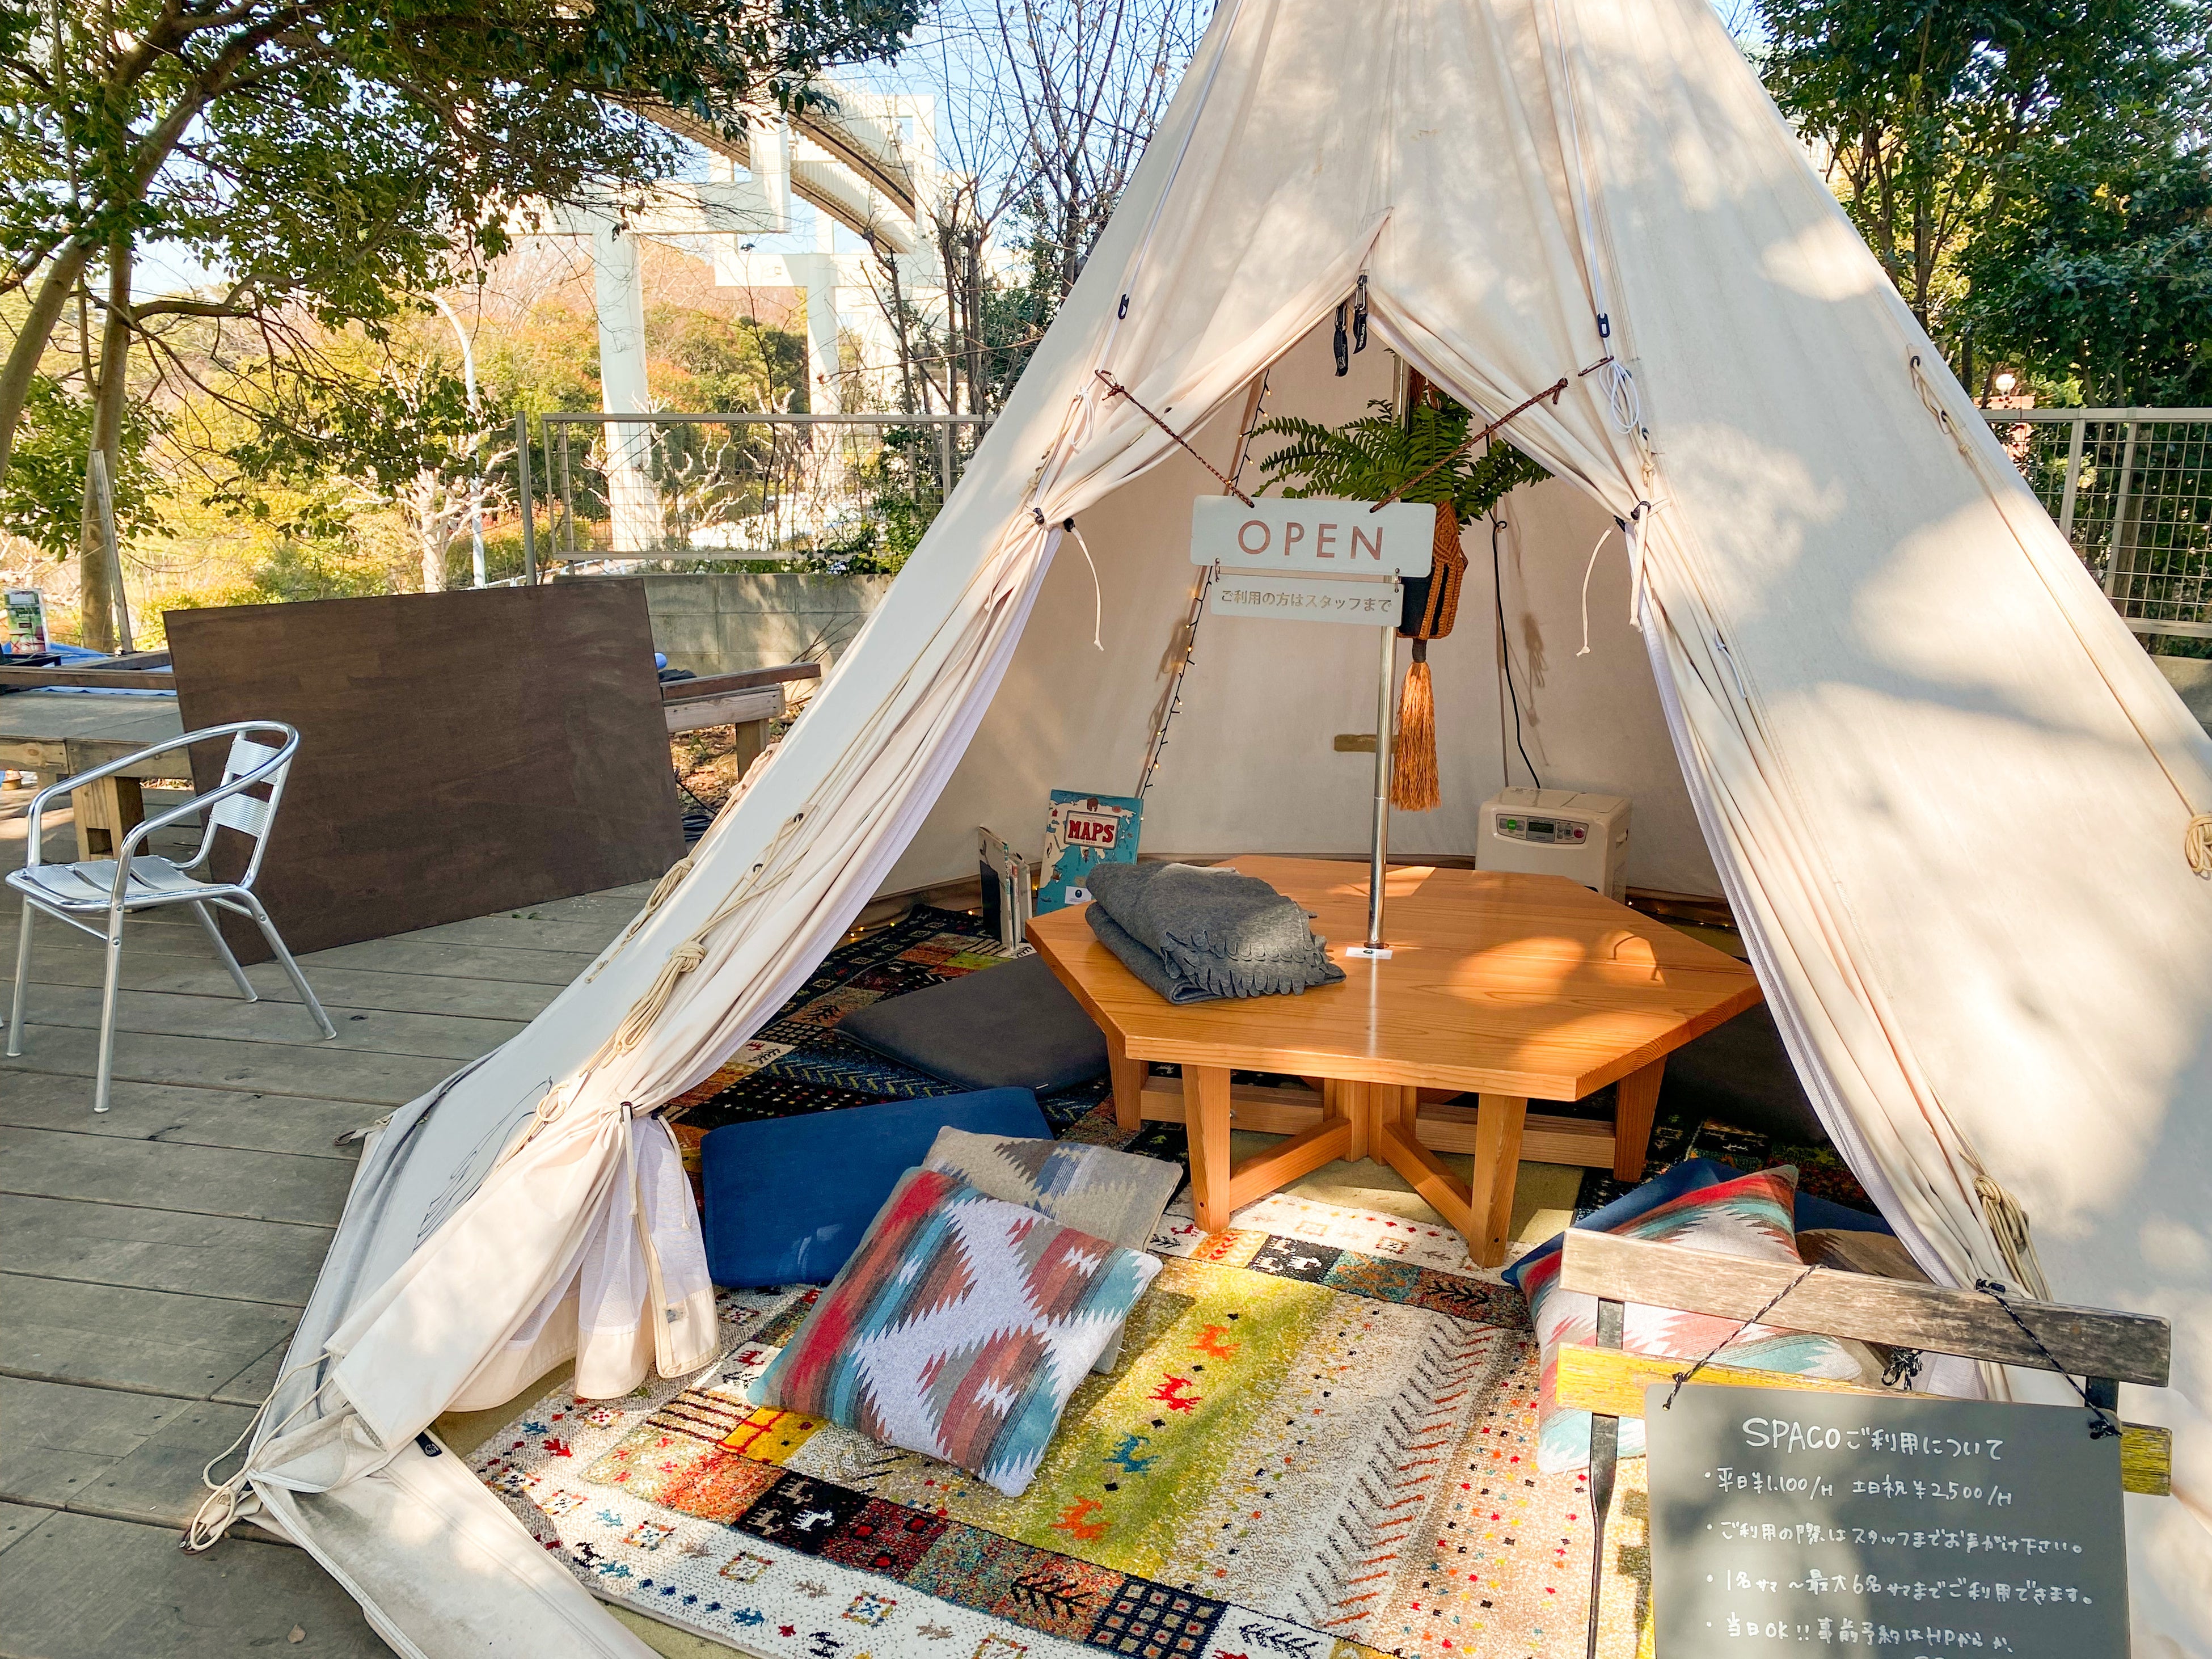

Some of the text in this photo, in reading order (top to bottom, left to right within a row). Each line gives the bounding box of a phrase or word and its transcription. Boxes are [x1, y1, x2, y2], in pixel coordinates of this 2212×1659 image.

[1238, 520, 1383, 560] OPEN
[1222, 590, 1392, 613] ご利用の方はスタッフまで
[1067, 820, 1115, 843] MAPS
